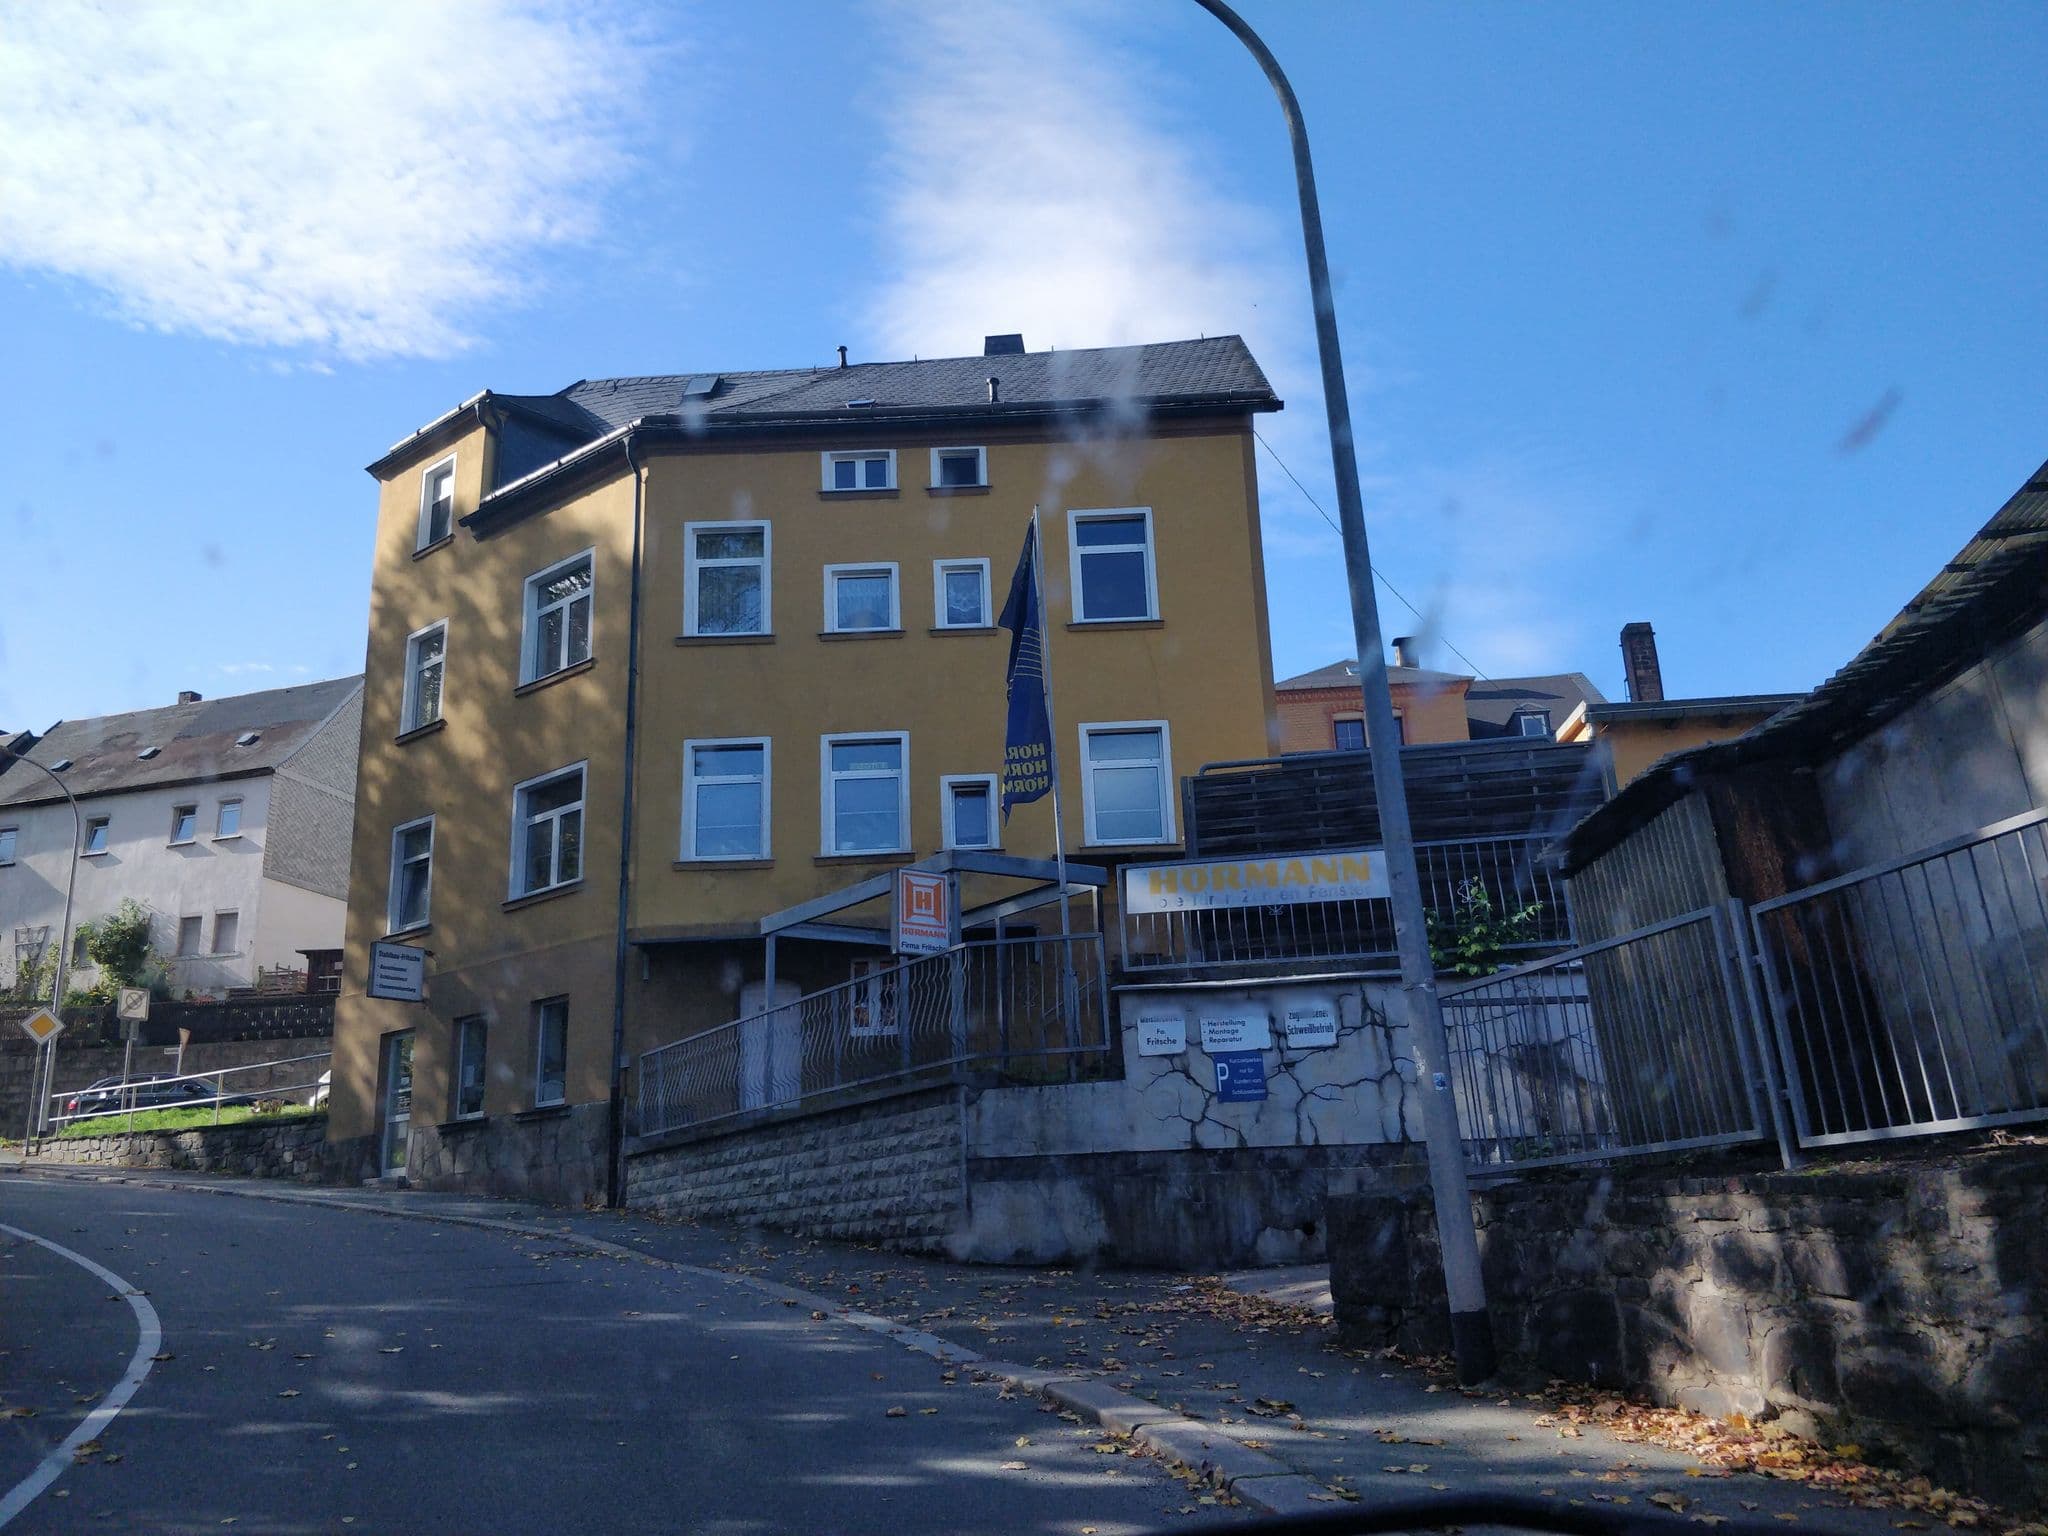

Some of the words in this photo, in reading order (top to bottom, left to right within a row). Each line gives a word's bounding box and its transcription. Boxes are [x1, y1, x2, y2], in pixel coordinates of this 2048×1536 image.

[901, 941, 920, 950] Firma
[1207, 1019, 1246, 1027] Herstellung
[1208, 1028, 1239, 1036] Montage
[1147, 1036, 1177, 1046] Fritsche
